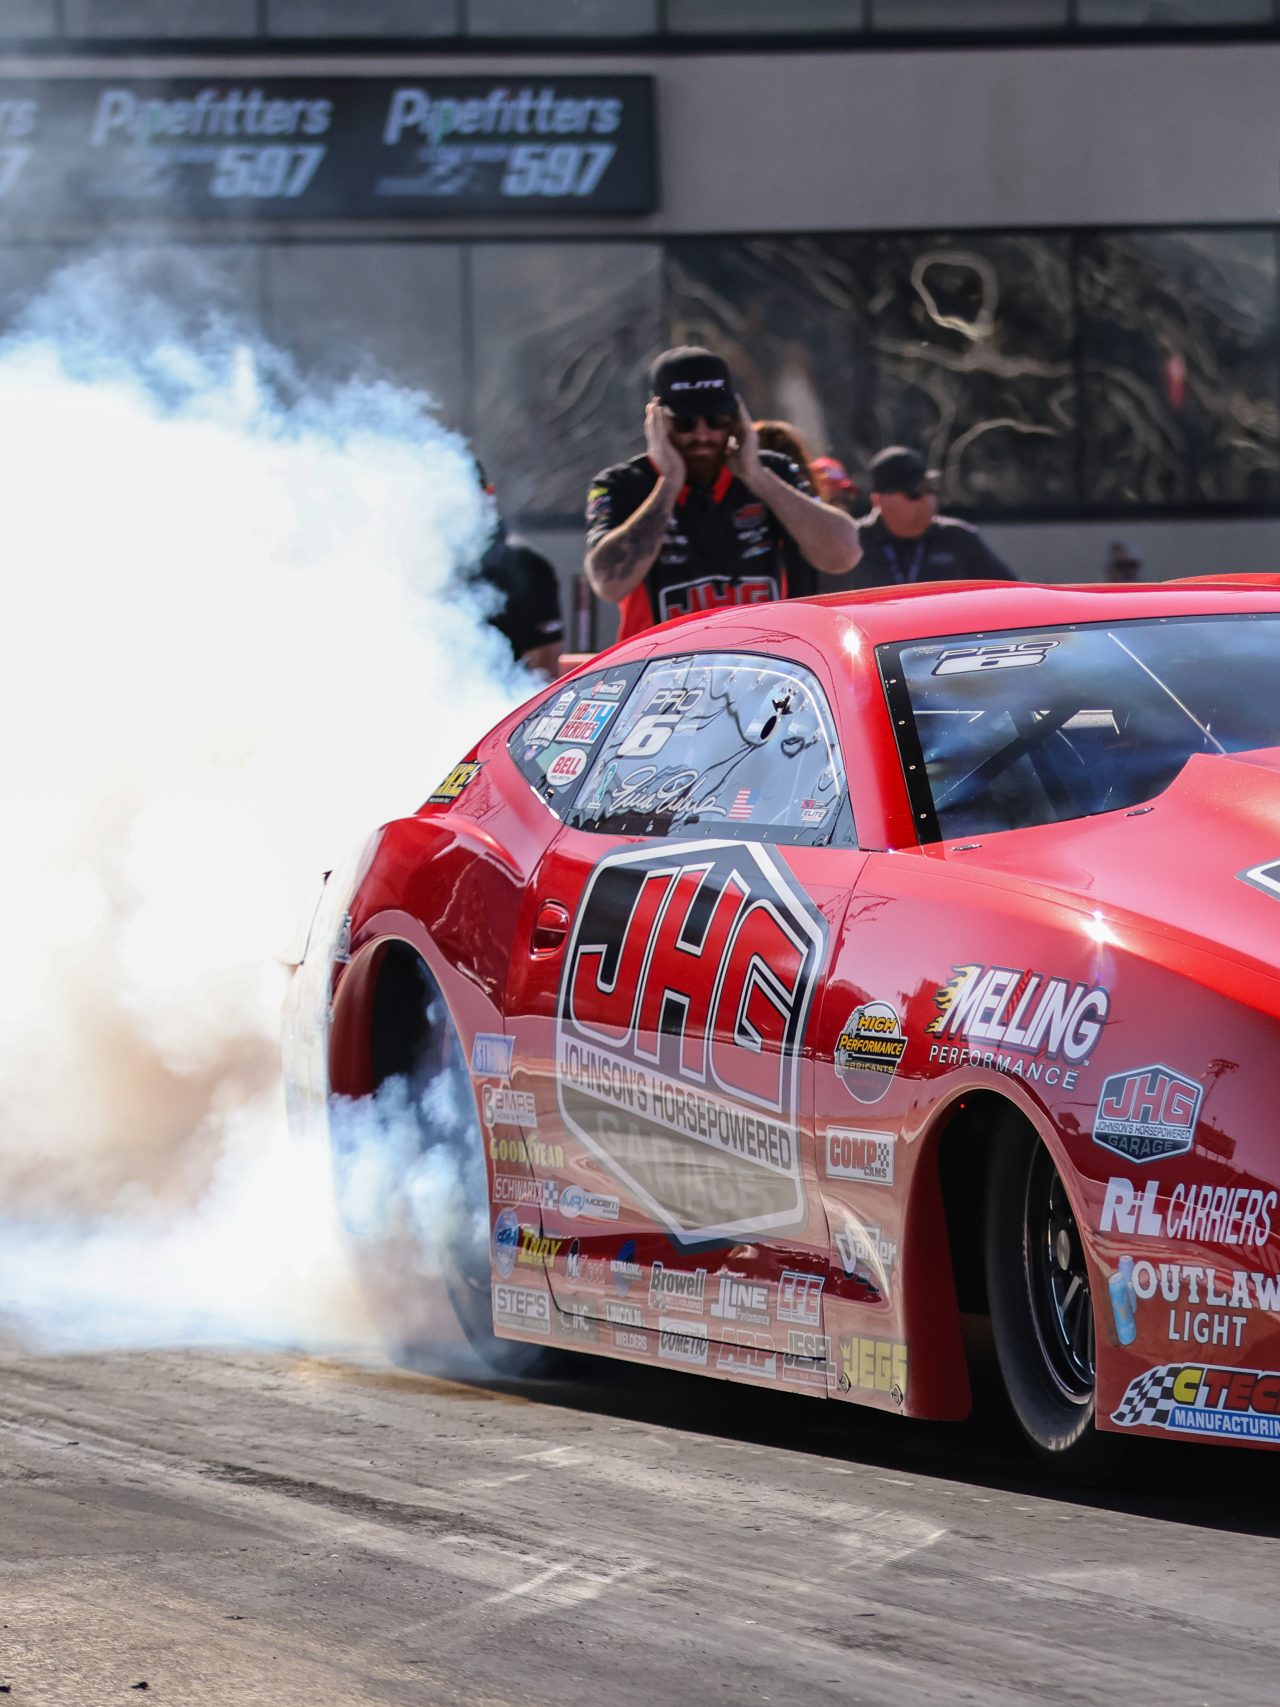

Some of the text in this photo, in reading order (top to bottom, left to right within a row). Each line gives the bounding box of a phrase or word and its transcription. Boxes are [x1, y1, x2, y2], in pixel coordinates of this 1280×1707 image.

[90, 88, 332, 146] Pipefitters
[383, 86, 623, 145] Pipefitters
[211, 145, 326, 197] 597
[502, 144, 617, 196] 597
[931, 652, 1047, 676] 6
[938, 641, 1061, 659] PRO
[643, 688, 705, 713] PRO
[560, 721, 598, 739] HEROES
[616, 714, 684, 757] 6
[552, 757, 581, 776] BELL
[570, 862, 808, 1113] JHG
[857, 1016, 898, 1034] HIGH
[937, 966, 1108, 1060] MELLING
[838, 1034, 904, 1056] PERFORMANCE
[928, 1045, 1080, 1090] PERFORMANCE
[561, 1043, 648, 1111] JOHNSON'S
[653, 1076, 792, 1171] HORSEPOWERED
[1102, 1073, 1197, 1126] JHG
[1095, 1120, 1191, 1140] JOHNSON'S HORSEPOWERED
[1107, 1134, 1174, 1156] GARAGE
[489, 1133, 564, 1169] GOODYEAR
[830, 1134, 877, 1171] COMP
[863, 1164, 887, 1178] CAMS
[1166, 1183, 1278, 1247] CARRIERS
[521, 1229, 562, 1257] INDY
[651, 1263, 707, 1298] Browell
[497, 1287, 547, 1318] STEF'S
[615, 1331, 648, 1352] WELDERS
[1168, 1309, 1247, 1347] LIGHT
[841, 1337, 908, 1392] JEGS
